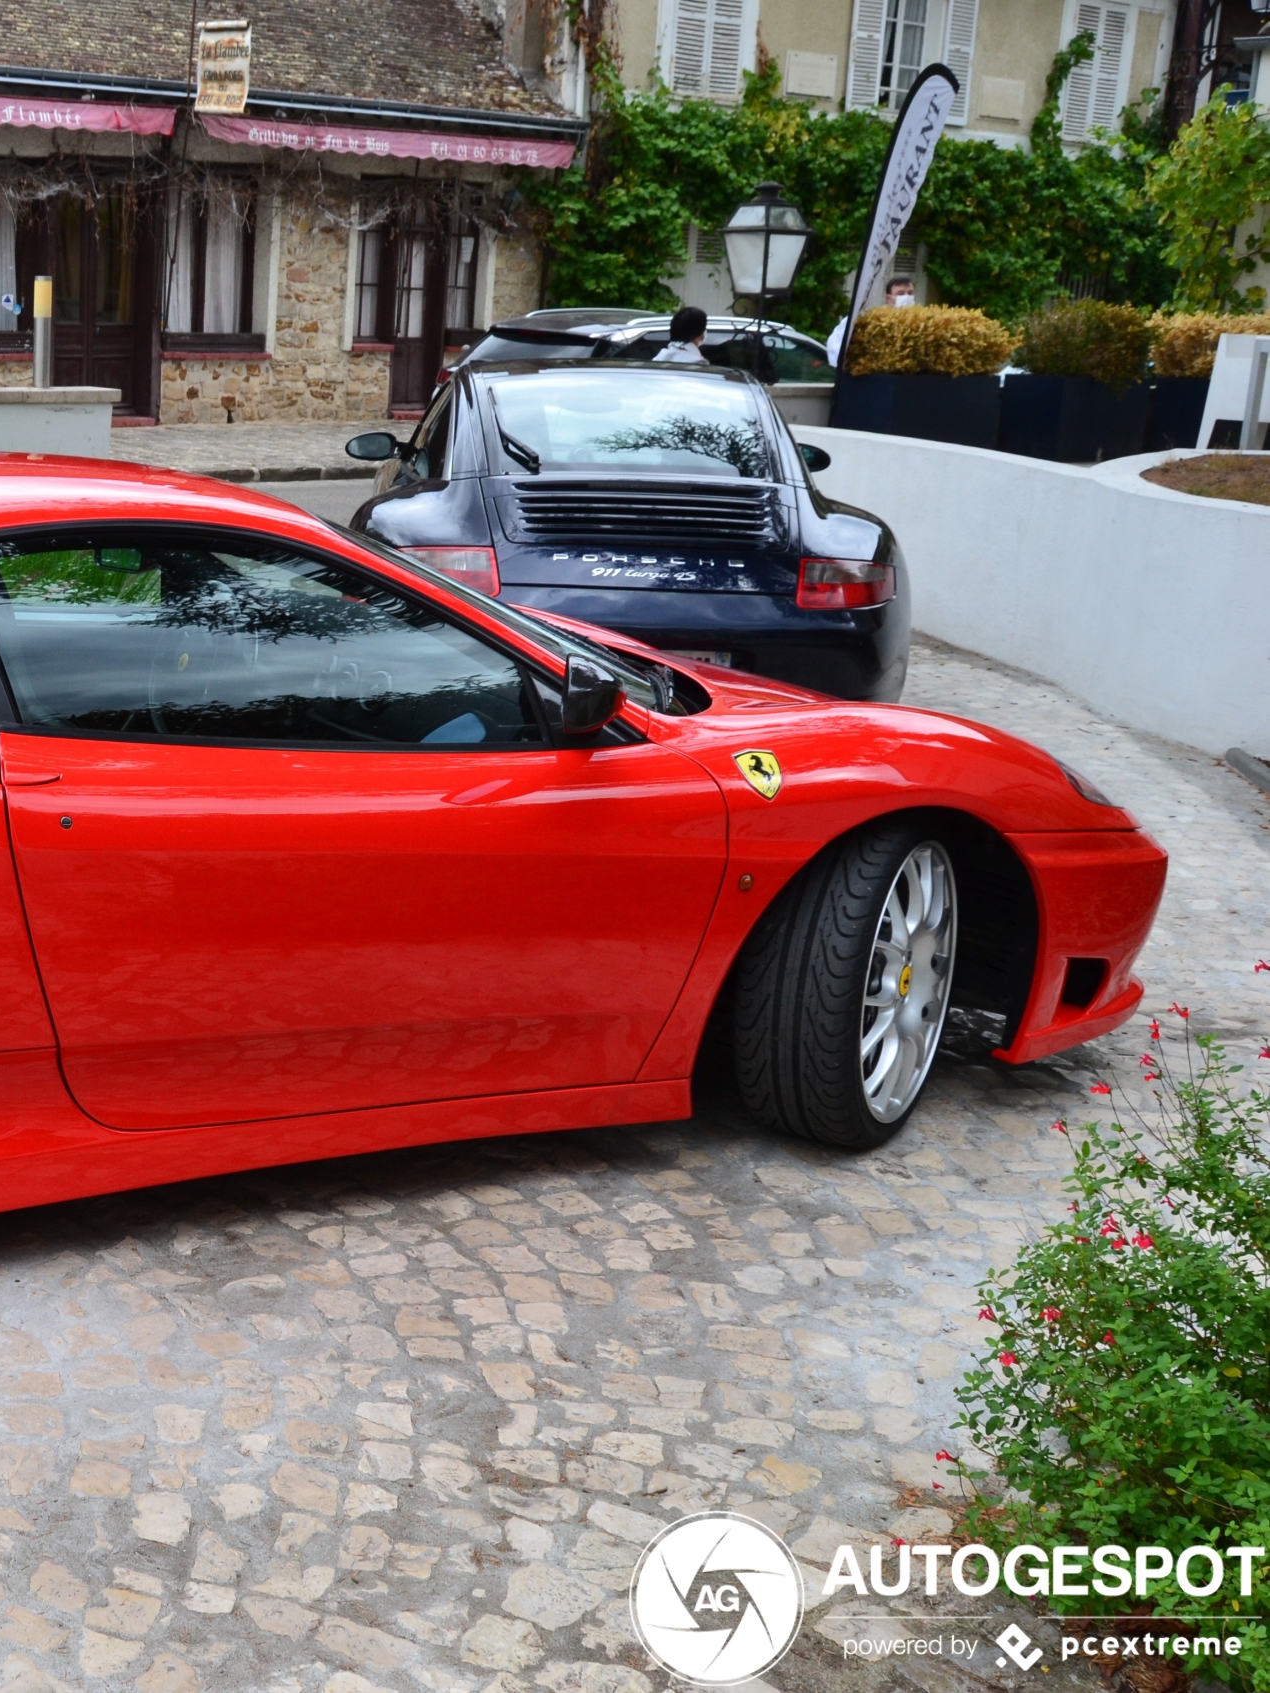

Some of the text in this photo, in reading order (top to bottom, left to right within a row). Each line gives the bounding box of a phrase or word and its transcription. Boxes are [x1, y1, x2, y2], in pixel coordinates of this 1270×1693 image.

[0, 105, 81, 125] Flambée
[365, 136, 390, 152] Bois
[457, 144, 468, 157] 01
[473, 146, 487, 159] 60
[509, 149, 522, 162] 40
[552, 552, 745, 568] PORSCHE
[591, 567, 622, 577] 911
[625, 570, 670, 580] targa
